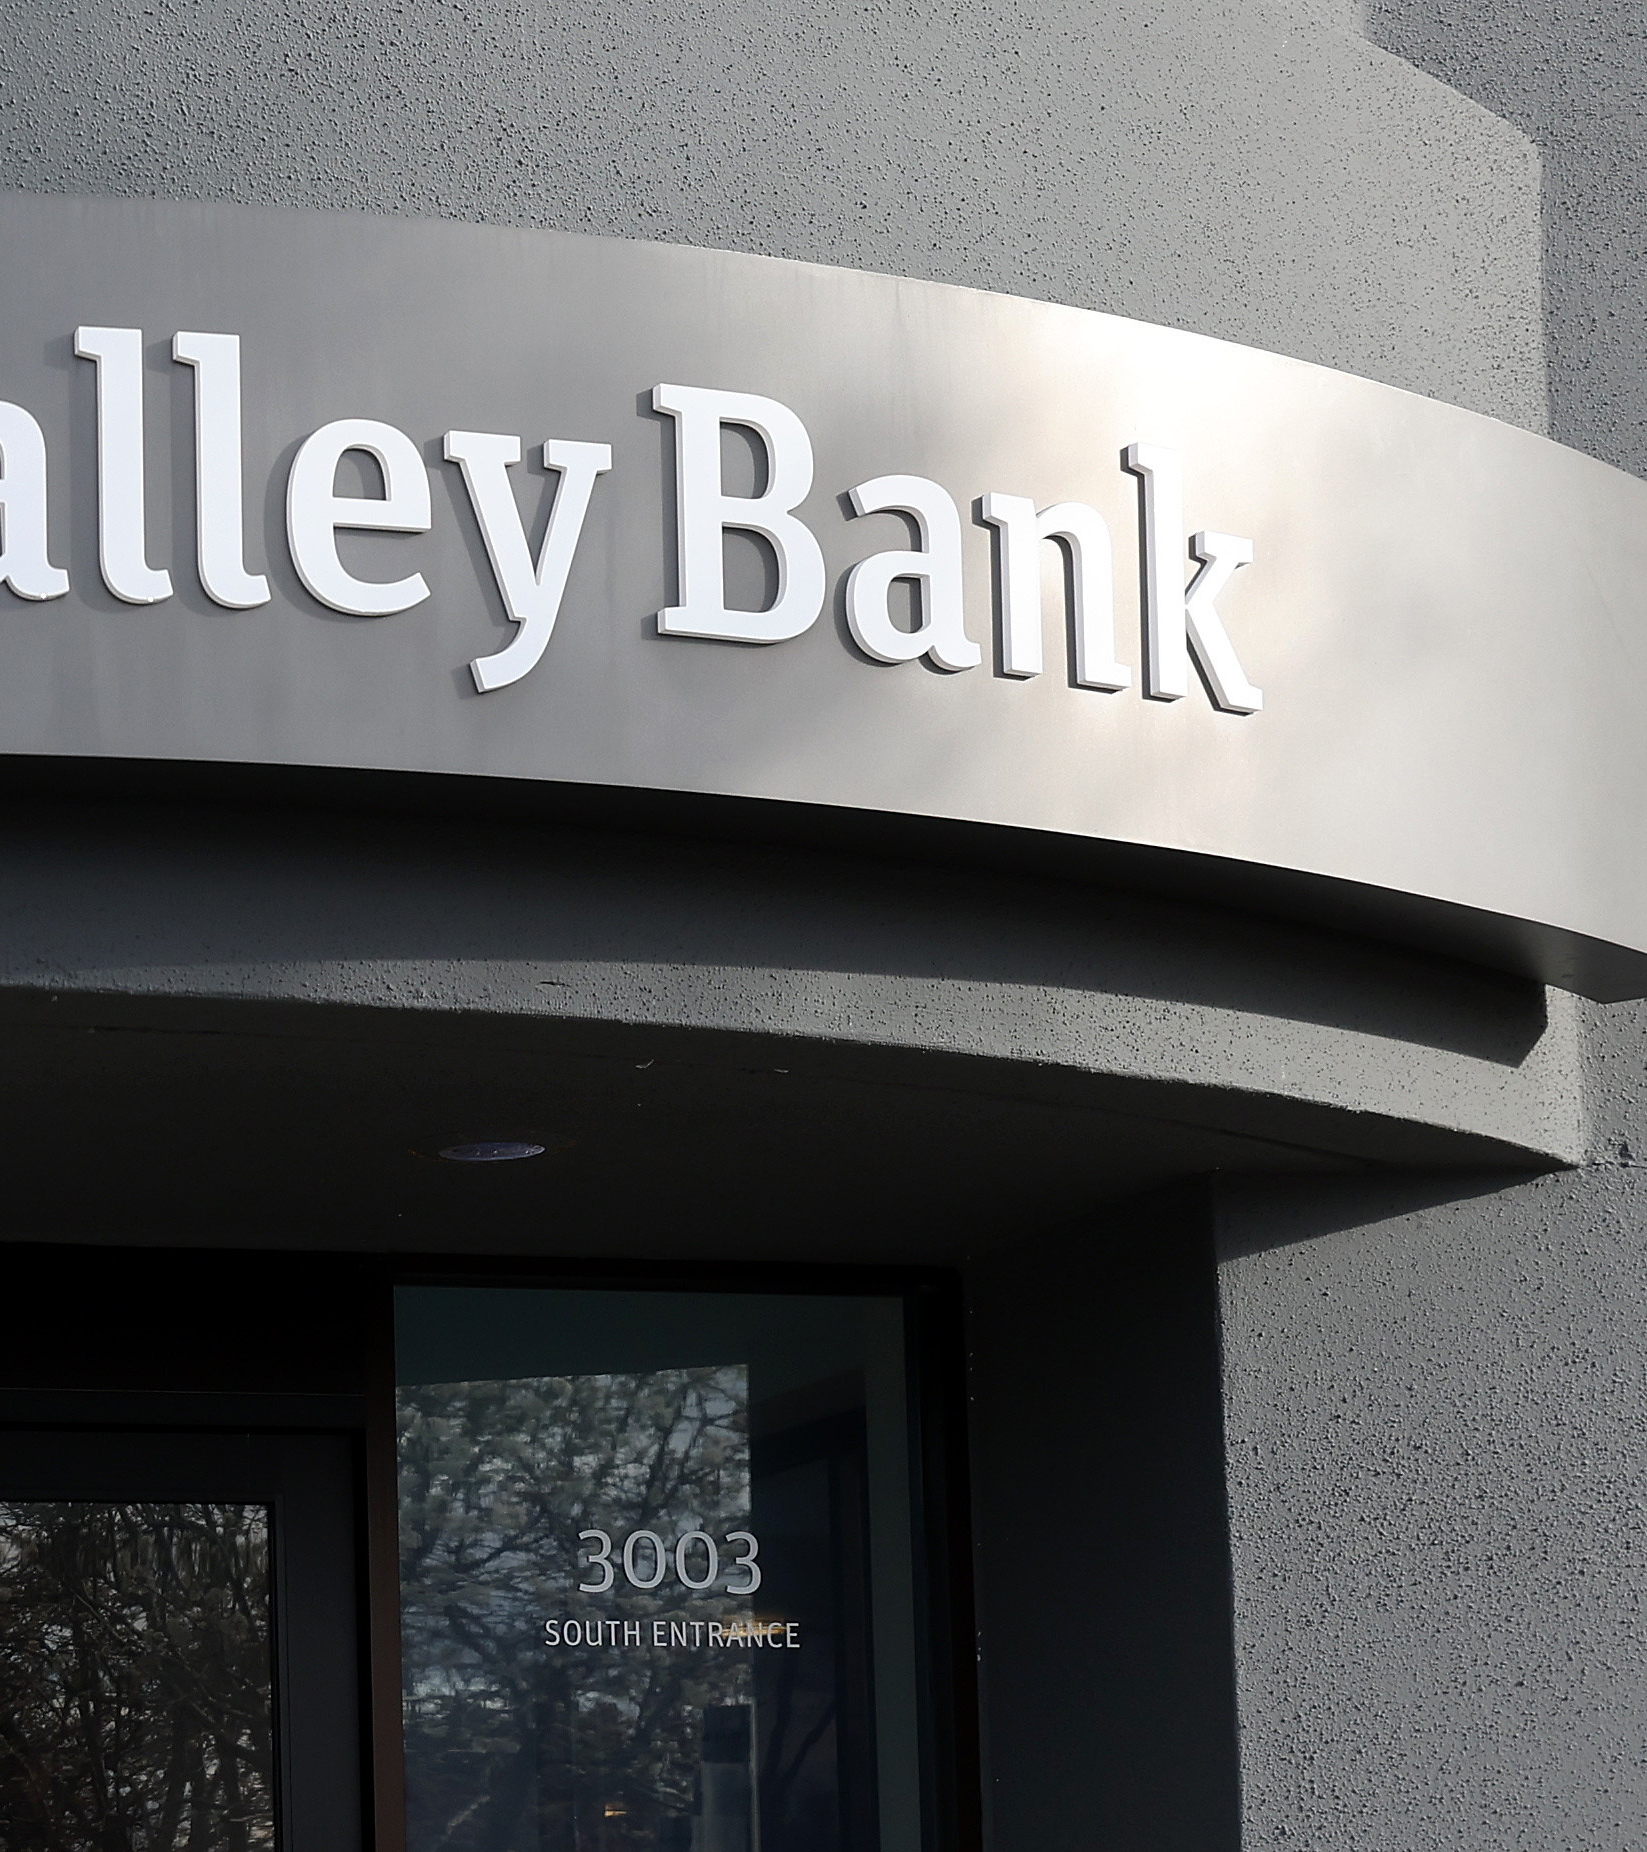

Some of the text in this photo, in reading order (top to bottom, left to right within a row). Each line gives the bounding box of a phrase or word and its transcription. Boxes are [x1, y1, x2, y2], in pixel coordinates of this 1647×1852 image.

[650, 382, 1265, 716] Bank
[576, 1528, 763, 1596] 3003
[543, 1618, 801, 1649] SOUTH ENTRANCE
